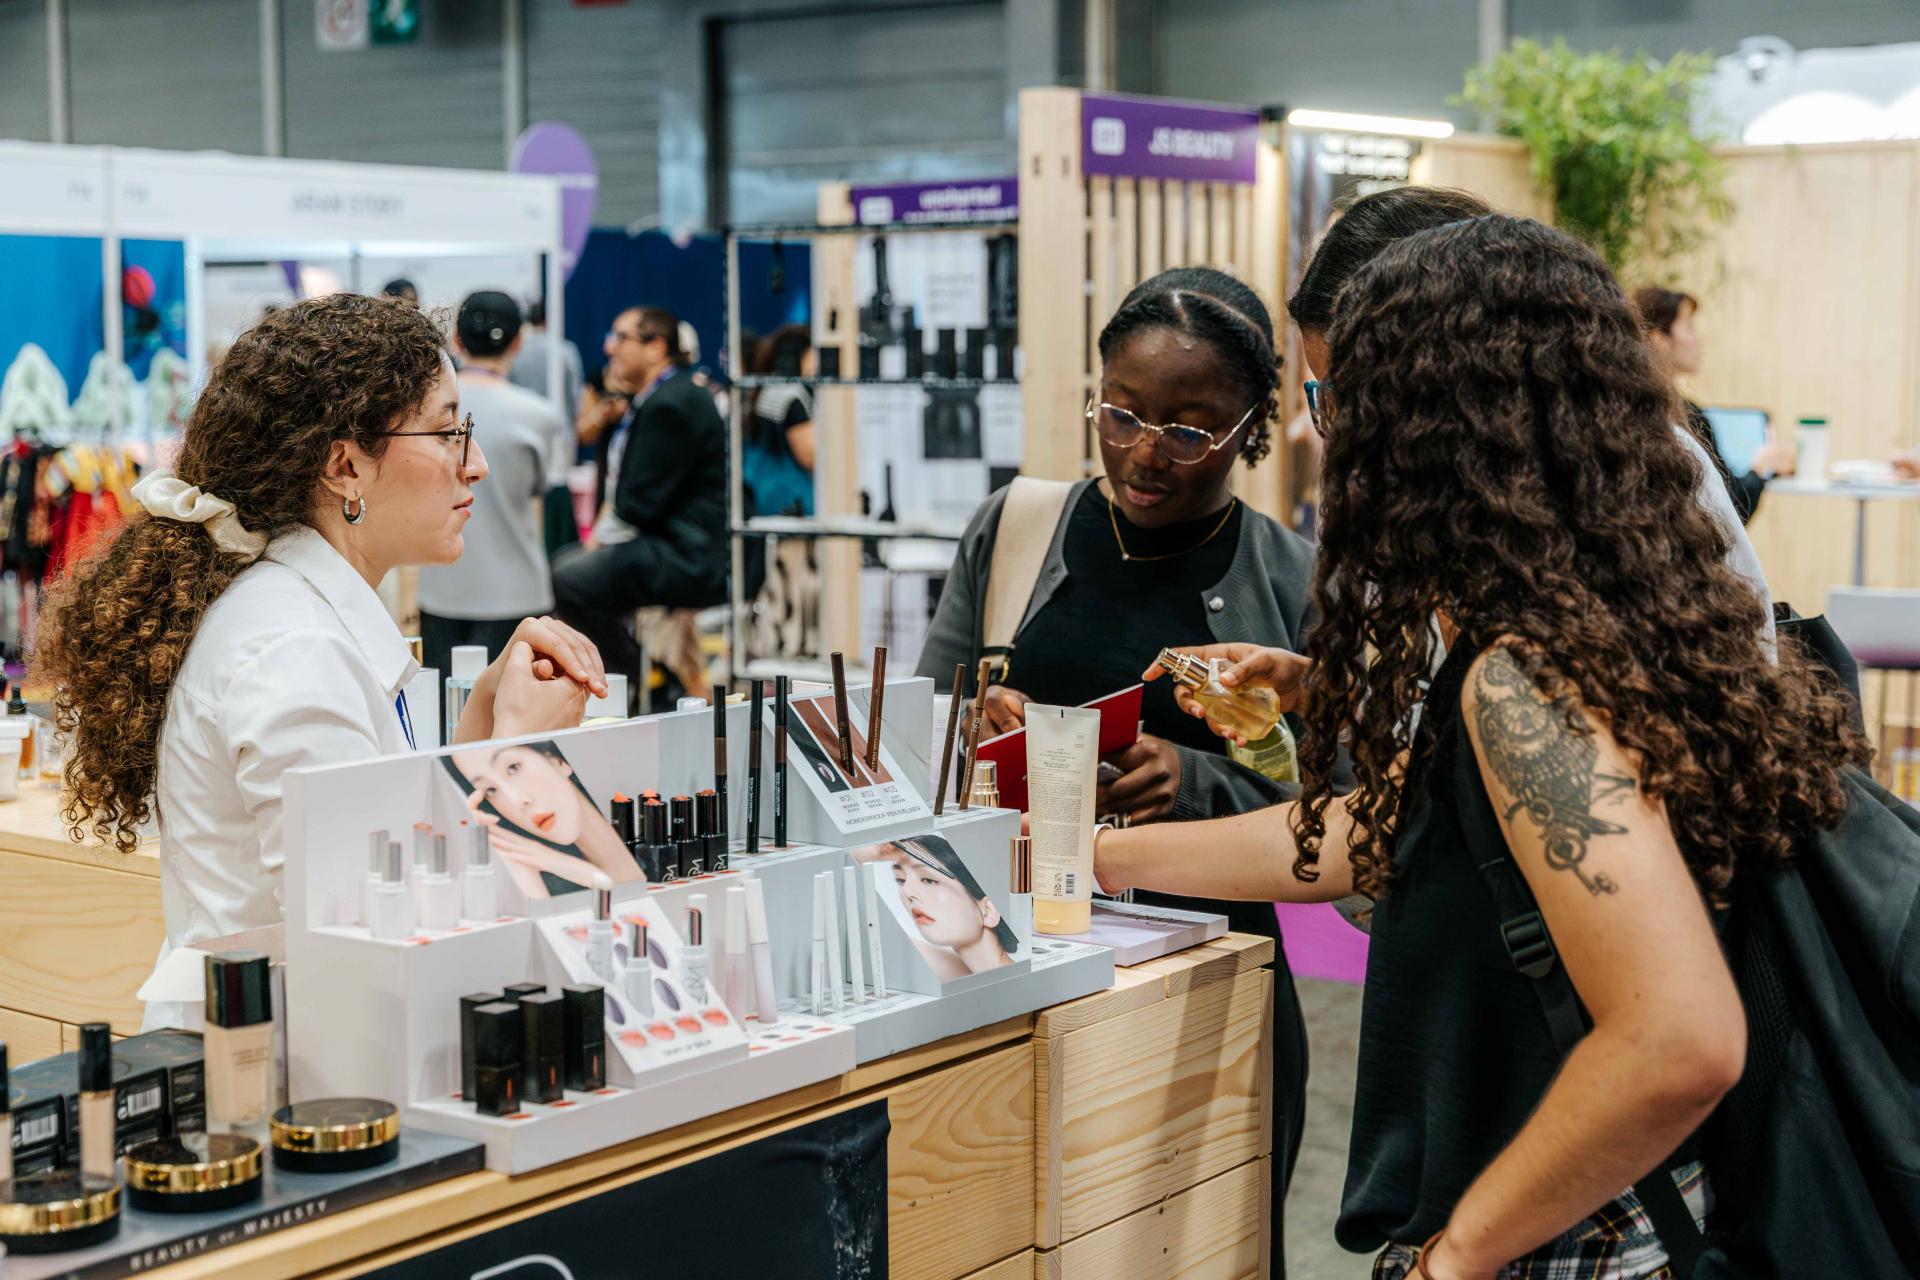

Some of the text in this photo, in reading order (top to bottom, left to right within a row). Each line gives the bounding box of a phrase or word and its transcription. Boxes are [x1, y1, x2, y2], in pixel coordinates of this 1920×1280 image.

[1172, 128, 1236, 161] BEAUTY
[130, 1236, 208, 1270] BEAUTY
[243, 1200, 327, 1235] MAJESTY
